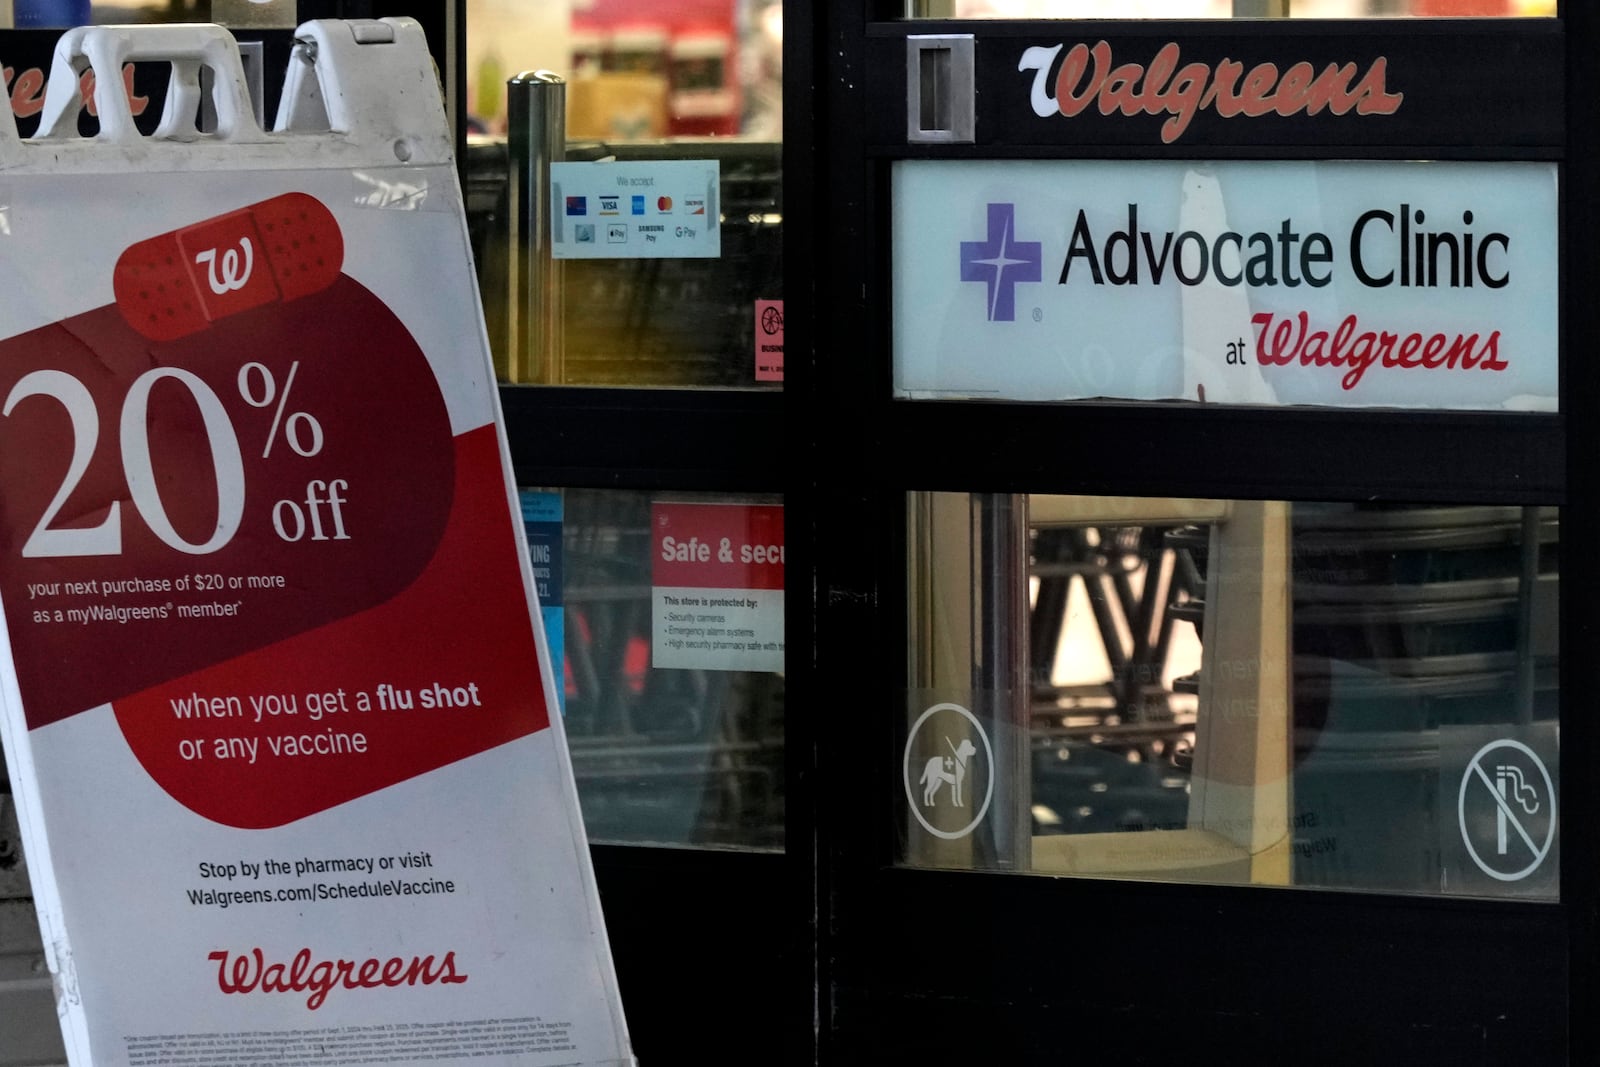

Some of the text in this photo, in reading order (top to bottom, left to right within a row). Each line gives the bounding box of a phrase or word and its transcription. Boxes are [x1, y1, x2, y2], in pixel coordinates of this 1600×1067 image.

[1018, 40, 1403, 143] Walgreens
[616, 176, 654, 187] We accept
[602, 201, 618, 210] VISA
[1058, 203, 1510, 288] Advocate Clinic
[1226, 311, 1509, 390] at Walgreens
[272, 479, 352, 542] off
[662, 536, 710, 562] Safe
[717, 537, 734, 563] &
[27, 573, 286, 600] your next purchase of $20 or more
[33, 609, 50, 623] as
[54, 609, 64, 622] a
[664, 596, 758, 609] This store is protected by:
[668, 612, 725, 624] Security cameras
[668, 625, 754, 638] Emergency alarm systems
[668, 639, 684, 649] High
[686, 640, 711, 651] security
[713, 641, 745, 651] pharmacy
[747, 641, 761, 650] safe
[763, 641, 777, 650] with
[169, 682, 482, 722] when you get a flu shot
[179, 727, 368, 763] or any vaccine
[199, 851, 433, 881] Stop by the pharmacy or visit
[187, 878, 455, 908] Walgreens.com/ScheduleVaccine
[208, 948, 468, 1010] Walgreens
